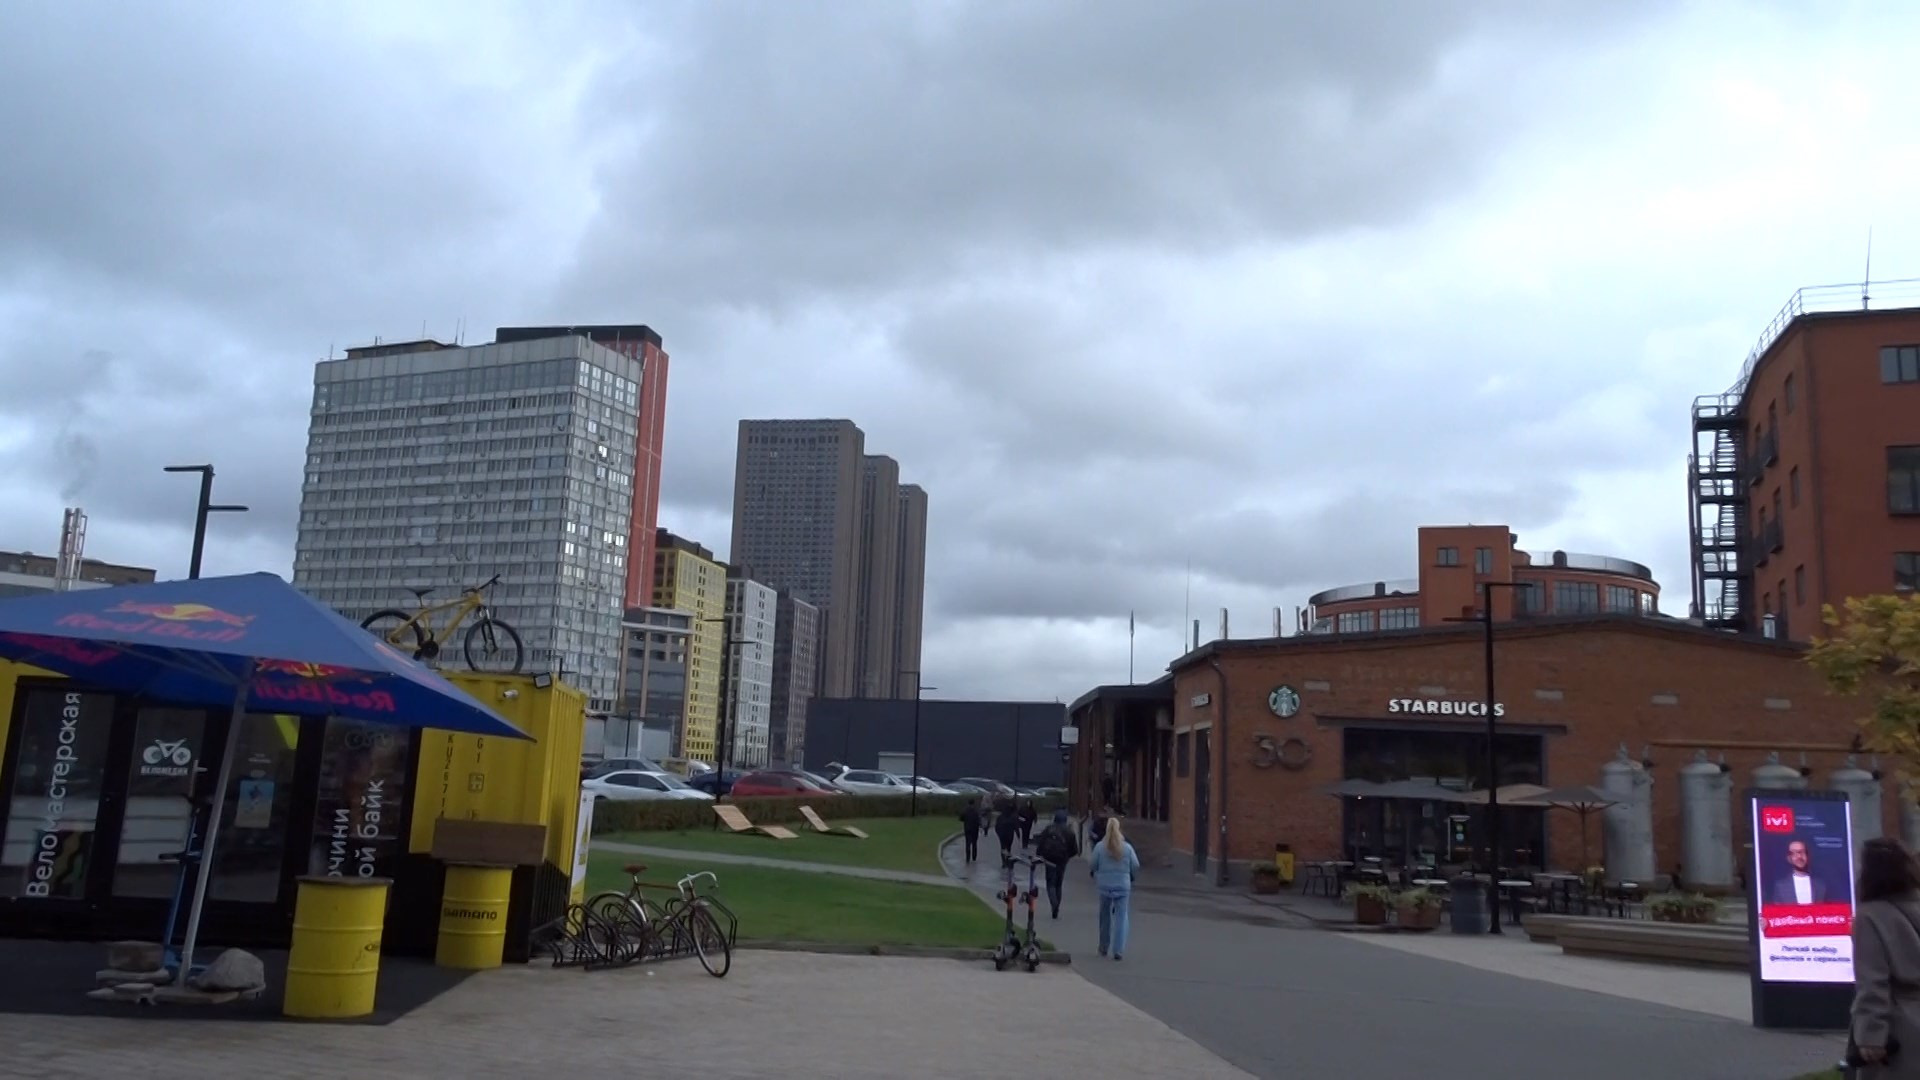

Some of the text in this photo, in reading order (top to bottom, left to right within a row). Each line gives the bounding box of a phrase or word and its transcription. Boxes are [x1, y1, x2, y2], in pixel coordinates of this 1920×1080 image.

[1389, 699, 1505, 716] STARBUCKS
[357, 780, 384, 838] байк
[1765, 813, 1788, 826] ivi
